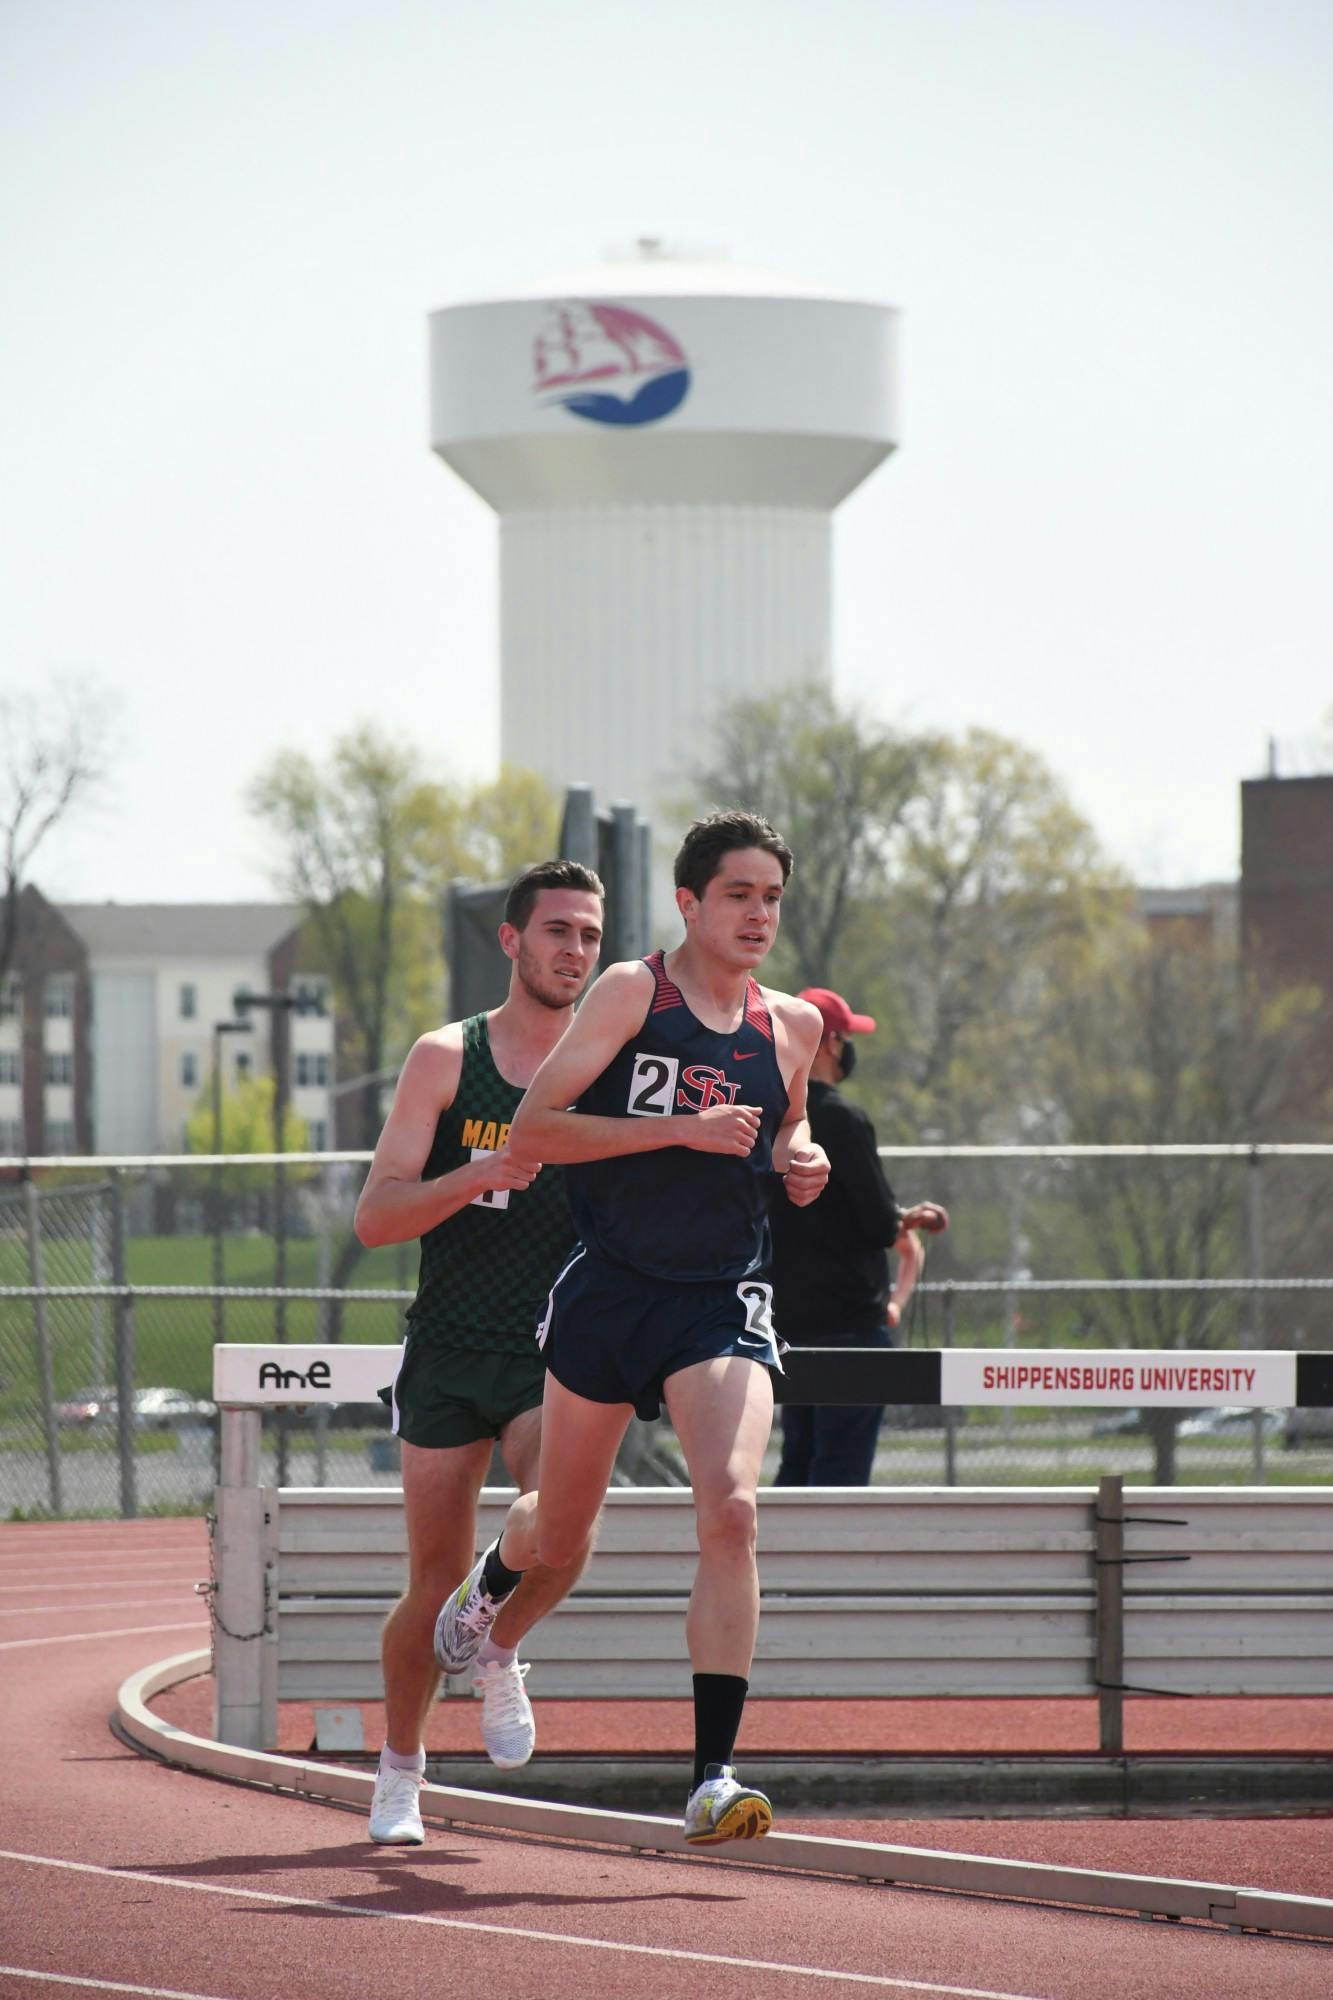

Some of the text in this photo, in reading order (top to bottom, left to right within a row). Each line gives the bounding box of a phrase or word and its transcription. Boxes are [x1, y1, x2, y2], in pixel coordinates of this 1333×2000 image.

[632, 1059, 669, 1114] 2
[742, 1286, 769, 1335] 2
[983, 1366, 1256, 1392] SHIPPENSBURG UNIVERSITY
